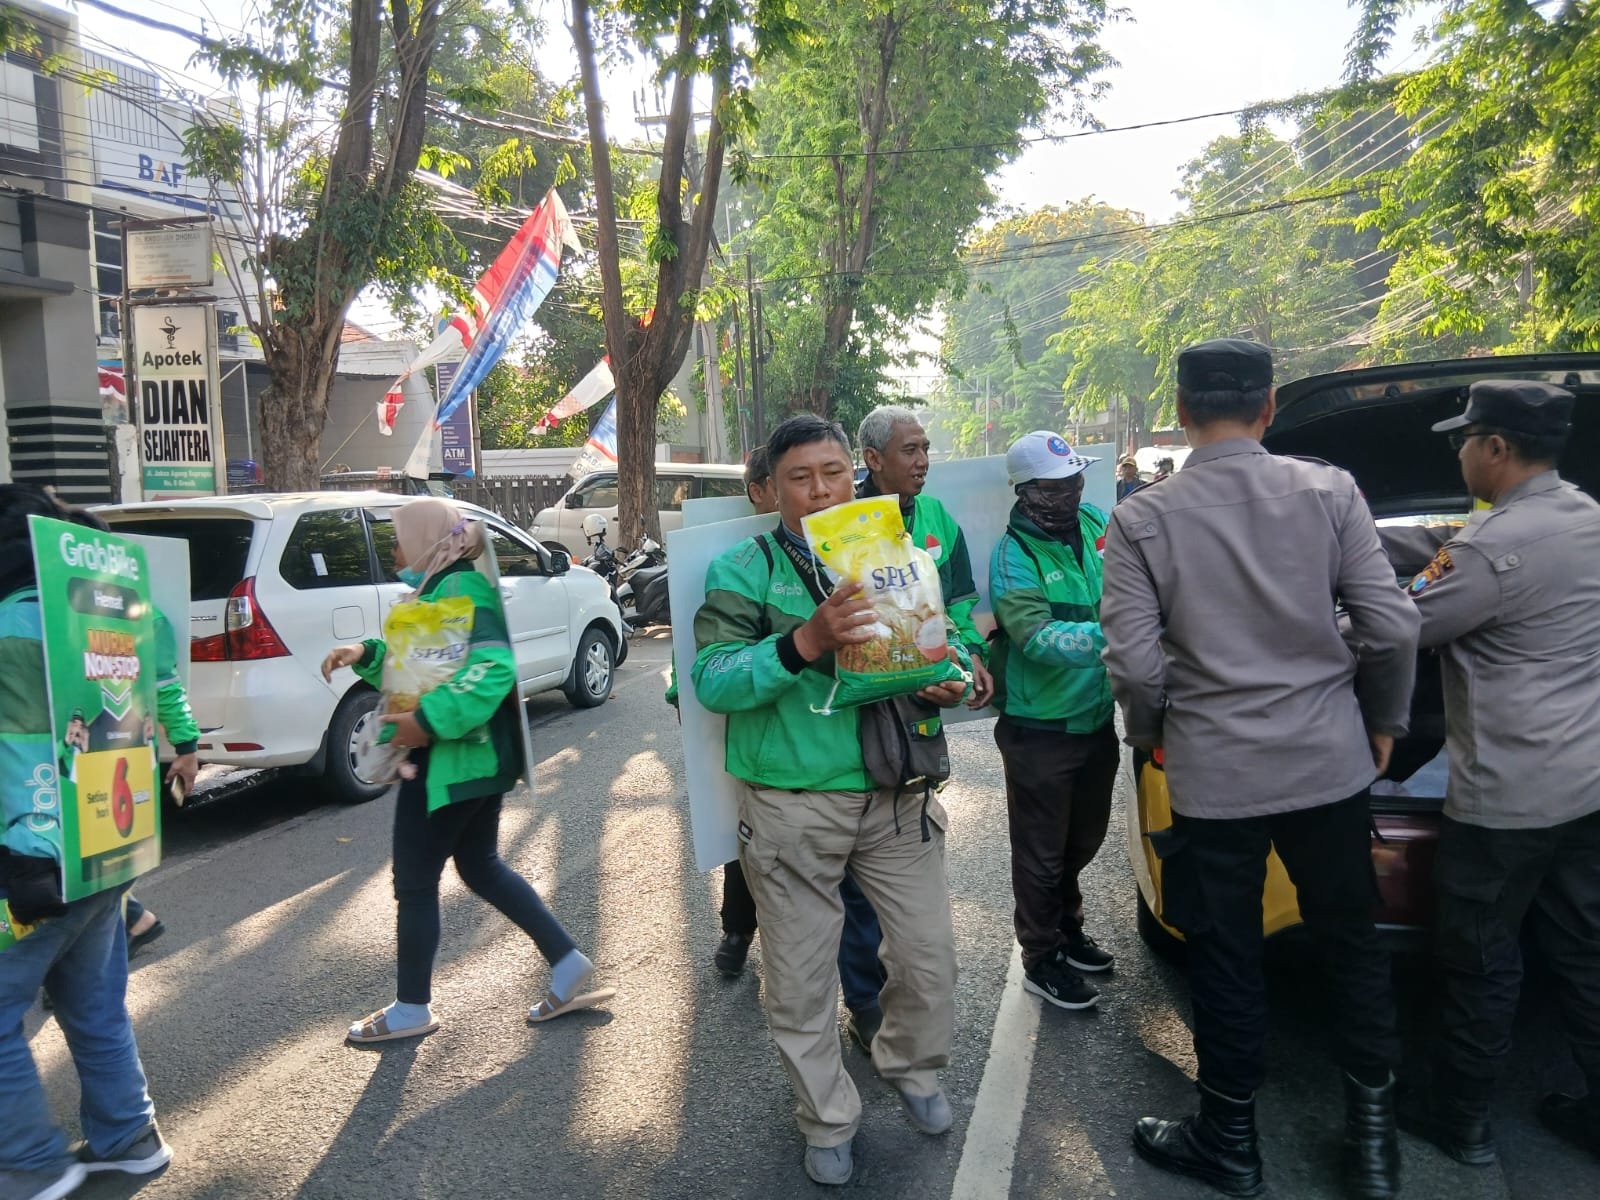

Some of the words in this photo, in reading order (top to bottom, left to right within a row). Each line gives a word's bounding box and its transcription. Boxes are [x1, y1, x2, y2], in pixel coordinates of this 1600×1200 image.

[138, 153, 186, 188] BAF
[142, 350, 203, 370] Apotek
[141, 379, 208, 424] DIAN
[144, 429, 211, 462] SEJAHTERA
[444, 448, 466, 458] ATM
[60, 533, 139, 581] GrabBike
[783, 541, 815, 575] SAMSUNG
[771, 582, 803, 596] Grab
[1036, 626, 1093, 652] Grab
[892, 650, 901, 662] 5
[112, 757, 134, 838] 6
